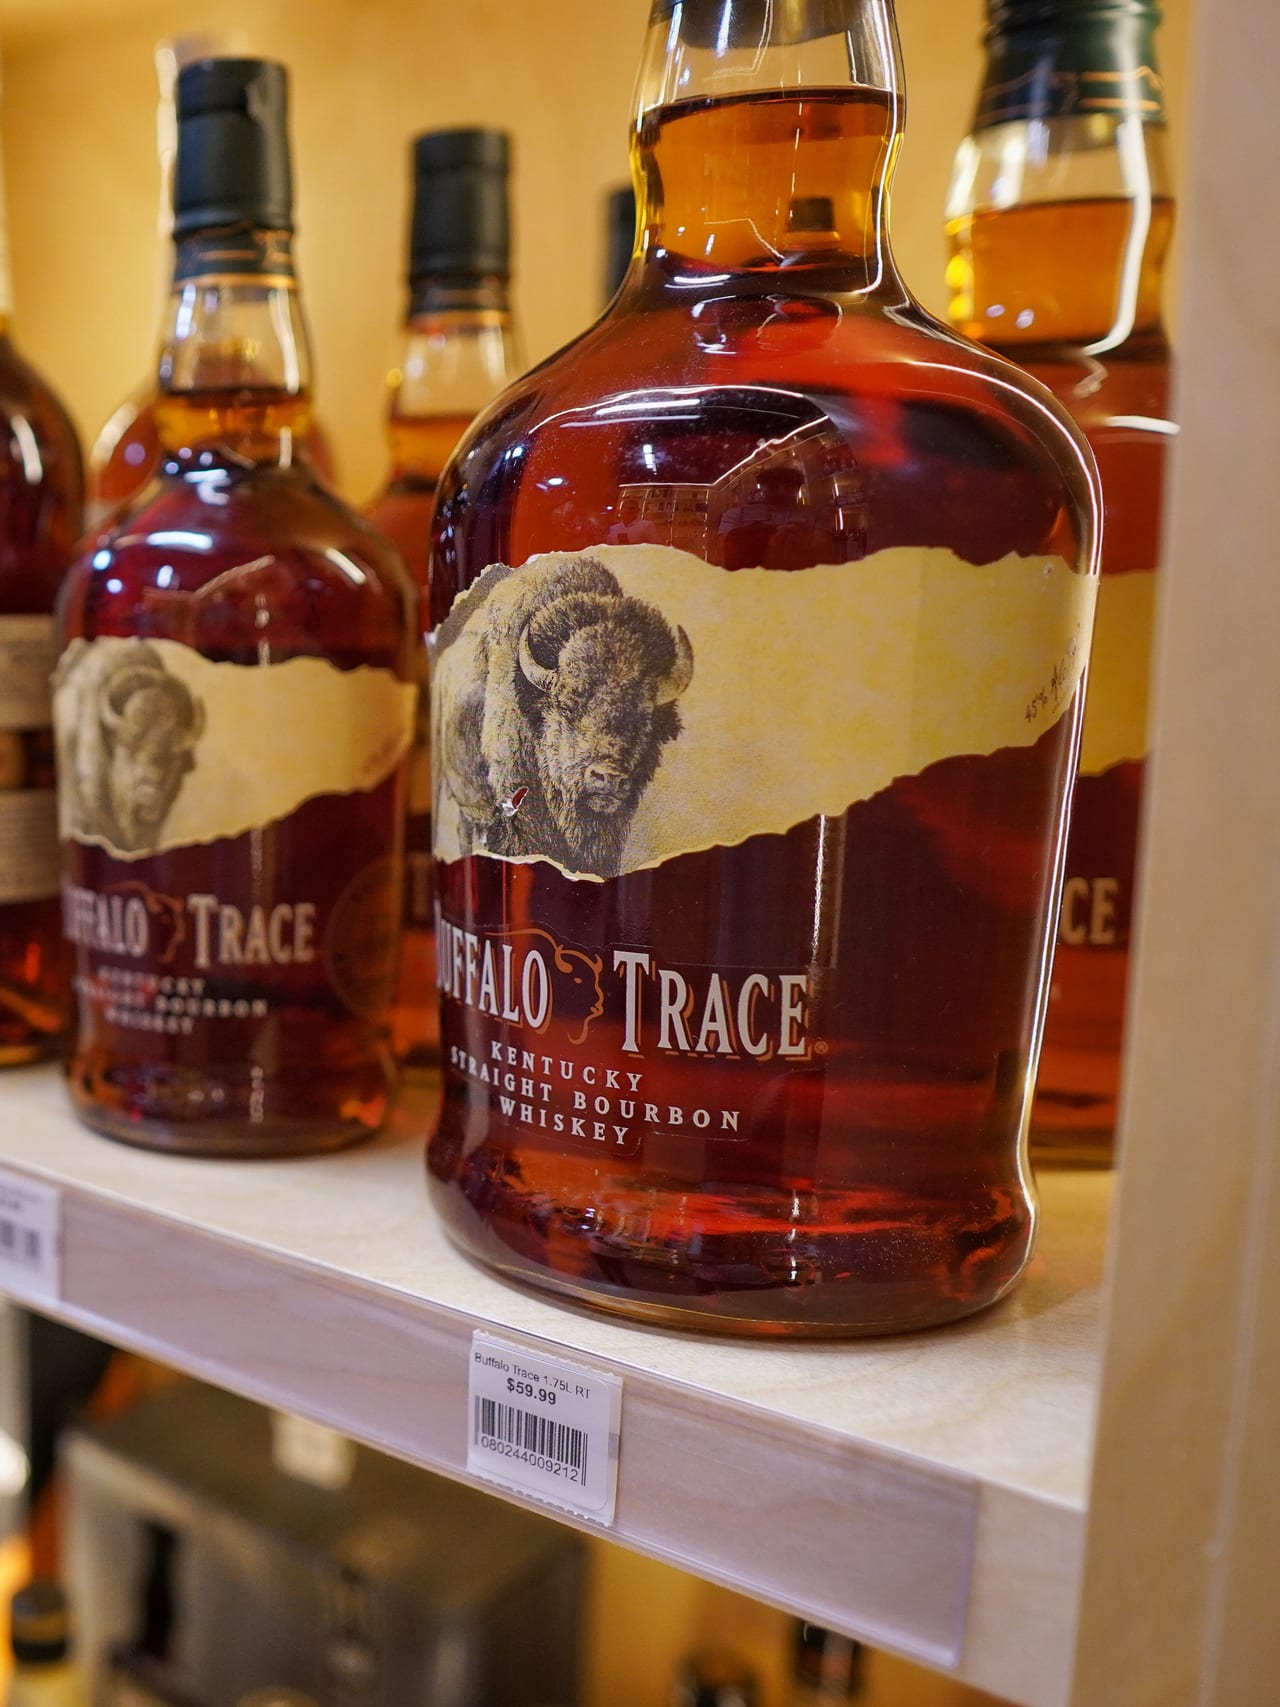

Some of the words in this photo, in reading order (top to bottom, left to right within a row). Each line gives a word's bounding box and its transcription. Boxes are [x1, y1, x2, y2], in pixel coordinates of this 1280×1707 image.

[187, 893, 316, 968] TRACE
[613, 950, 810, 1057] TRACE
[450, 1045, 552, 1102] STRAIGHT
[573, 1090, 741, 1133] BOURBON
[490, 1040, 643, 1093] KENTUCKY
[499, 1095, 630, 1146] WHISKEY
[474, 1352, 510, 1373] Buffalo
[513, 1364, 540, 1383] Trace
[543, 1375, 572, 1394] 1.75L
[575, 1385, 591, 1400] RT
[506, 1377, 557, 1406] $59.99
[480, 1435, 579, 1482] 080244009212
